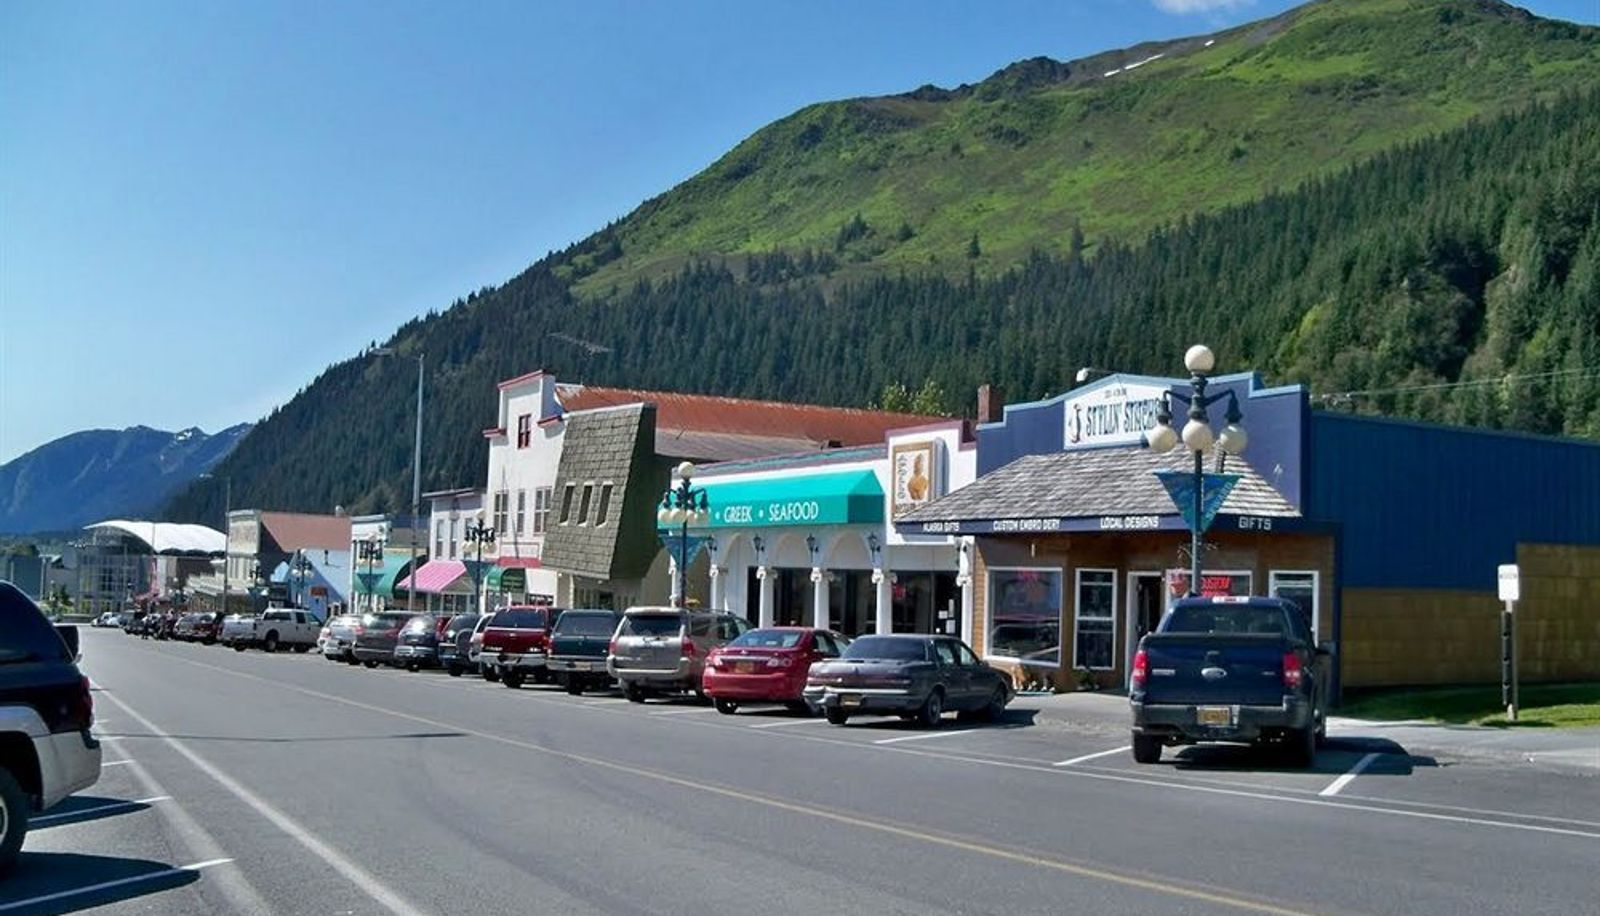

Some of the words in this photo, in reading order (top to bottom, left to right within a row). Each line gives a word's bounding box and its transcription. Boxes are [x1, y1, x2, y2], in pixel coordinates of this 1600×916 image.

[723, 506, 752, 523] GREEK
[769, 502, 819, 522] SEAFOOD
[993, 519, 1018, 531] CUSTOM
[1100, 517, 1123, 529] LOCAL
[1124, 516, 1159, 529] DESIGNS
[1238, 516, 1272, 531] GIFTS
